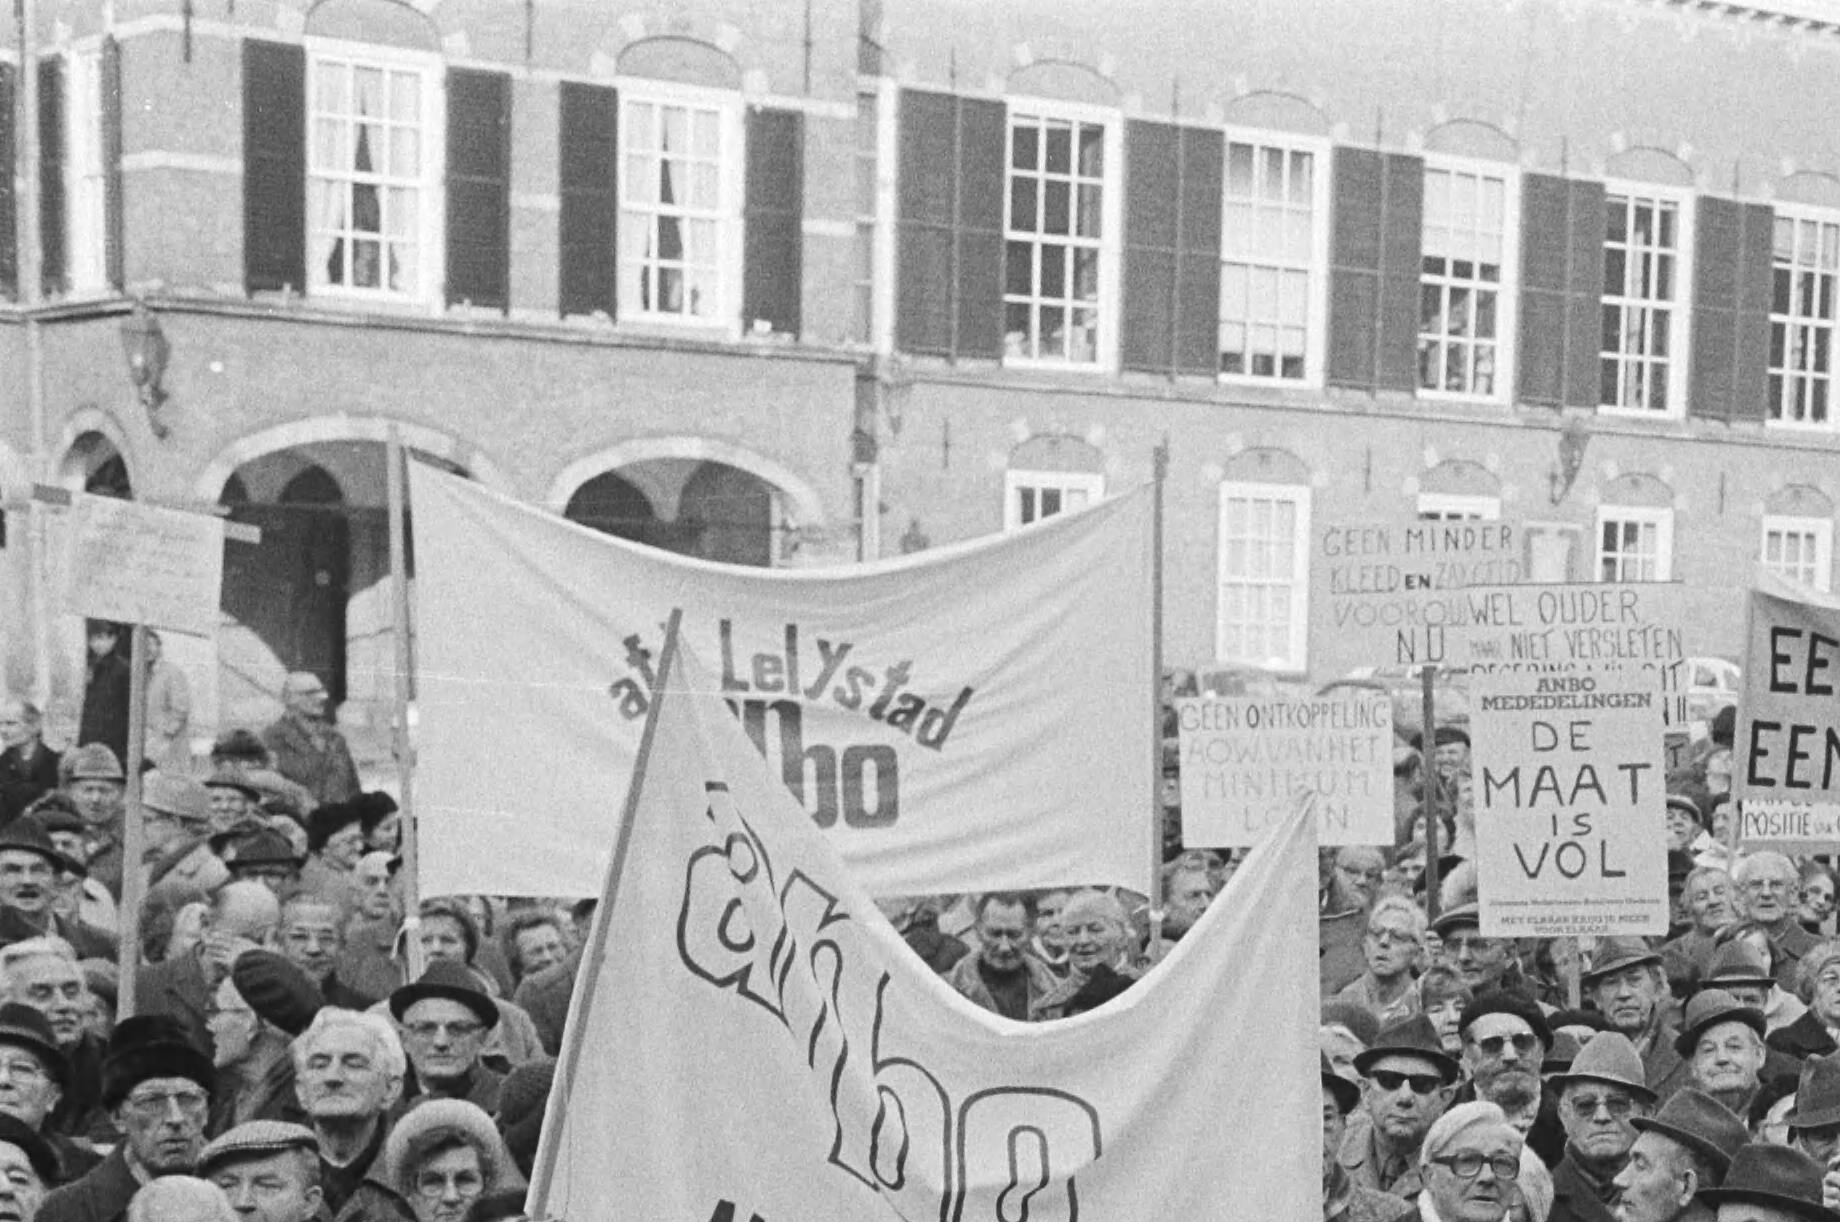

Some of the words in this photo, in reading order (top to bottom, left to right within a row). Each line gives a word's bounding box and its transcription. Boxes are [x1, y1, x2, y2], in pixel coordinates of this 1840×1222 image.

[1322, 526, 1390, 556] GEEN
[1404, 525, 1513, 553] MINDER
[1404, 573, 1431, 590] EN
[1468, 593, 1523, 627] WEL
[1537, 590, 1639, 624] OUDER
[1510, 629, 1555, 660] NIET
[1564, 627, 1684, 659] VERSLETEN
[720, 618, 974, 752] Lelystad
[1536, 677, 1597, 693] ANBO
[1179, 702, 1240, 731] GEEN
[1245, 701, 1387, 730] ONTKOPPELING
[1481, 693, 1652, 711] MEDEDELINGEN
[1532, 721, 1593, 751] DE
[1483, 762, 1653, 809] MAAT
[1244, 804, 1349, 832] LON
[1552, 812, 1593, 837] IS
[1513, 839, 1627, 880] VOL
